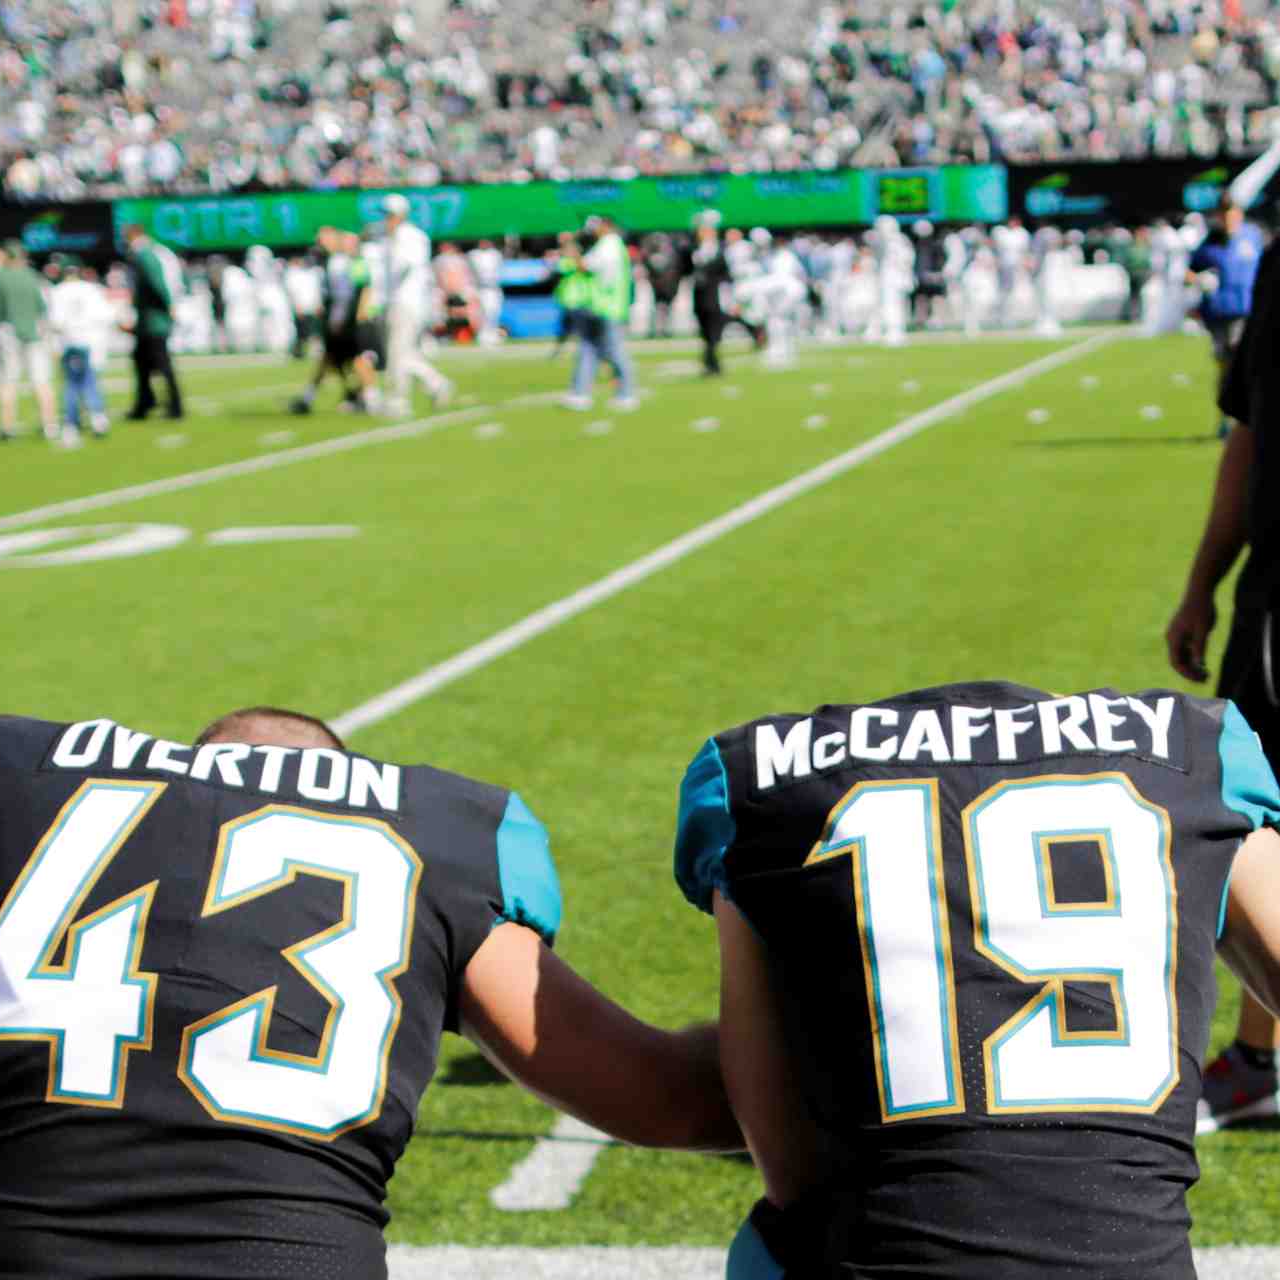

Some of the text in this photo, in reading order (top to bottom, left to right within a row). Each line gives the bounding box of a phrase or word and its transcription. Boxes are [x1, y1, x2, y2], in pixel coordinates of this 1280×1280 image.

[154, 200, 260, 247] QTR
[51, 718, 401, 812] OVERTON
[754, 693, 1175, 790] McCAFFREY
[803, 771, 1180, 1124] 19
